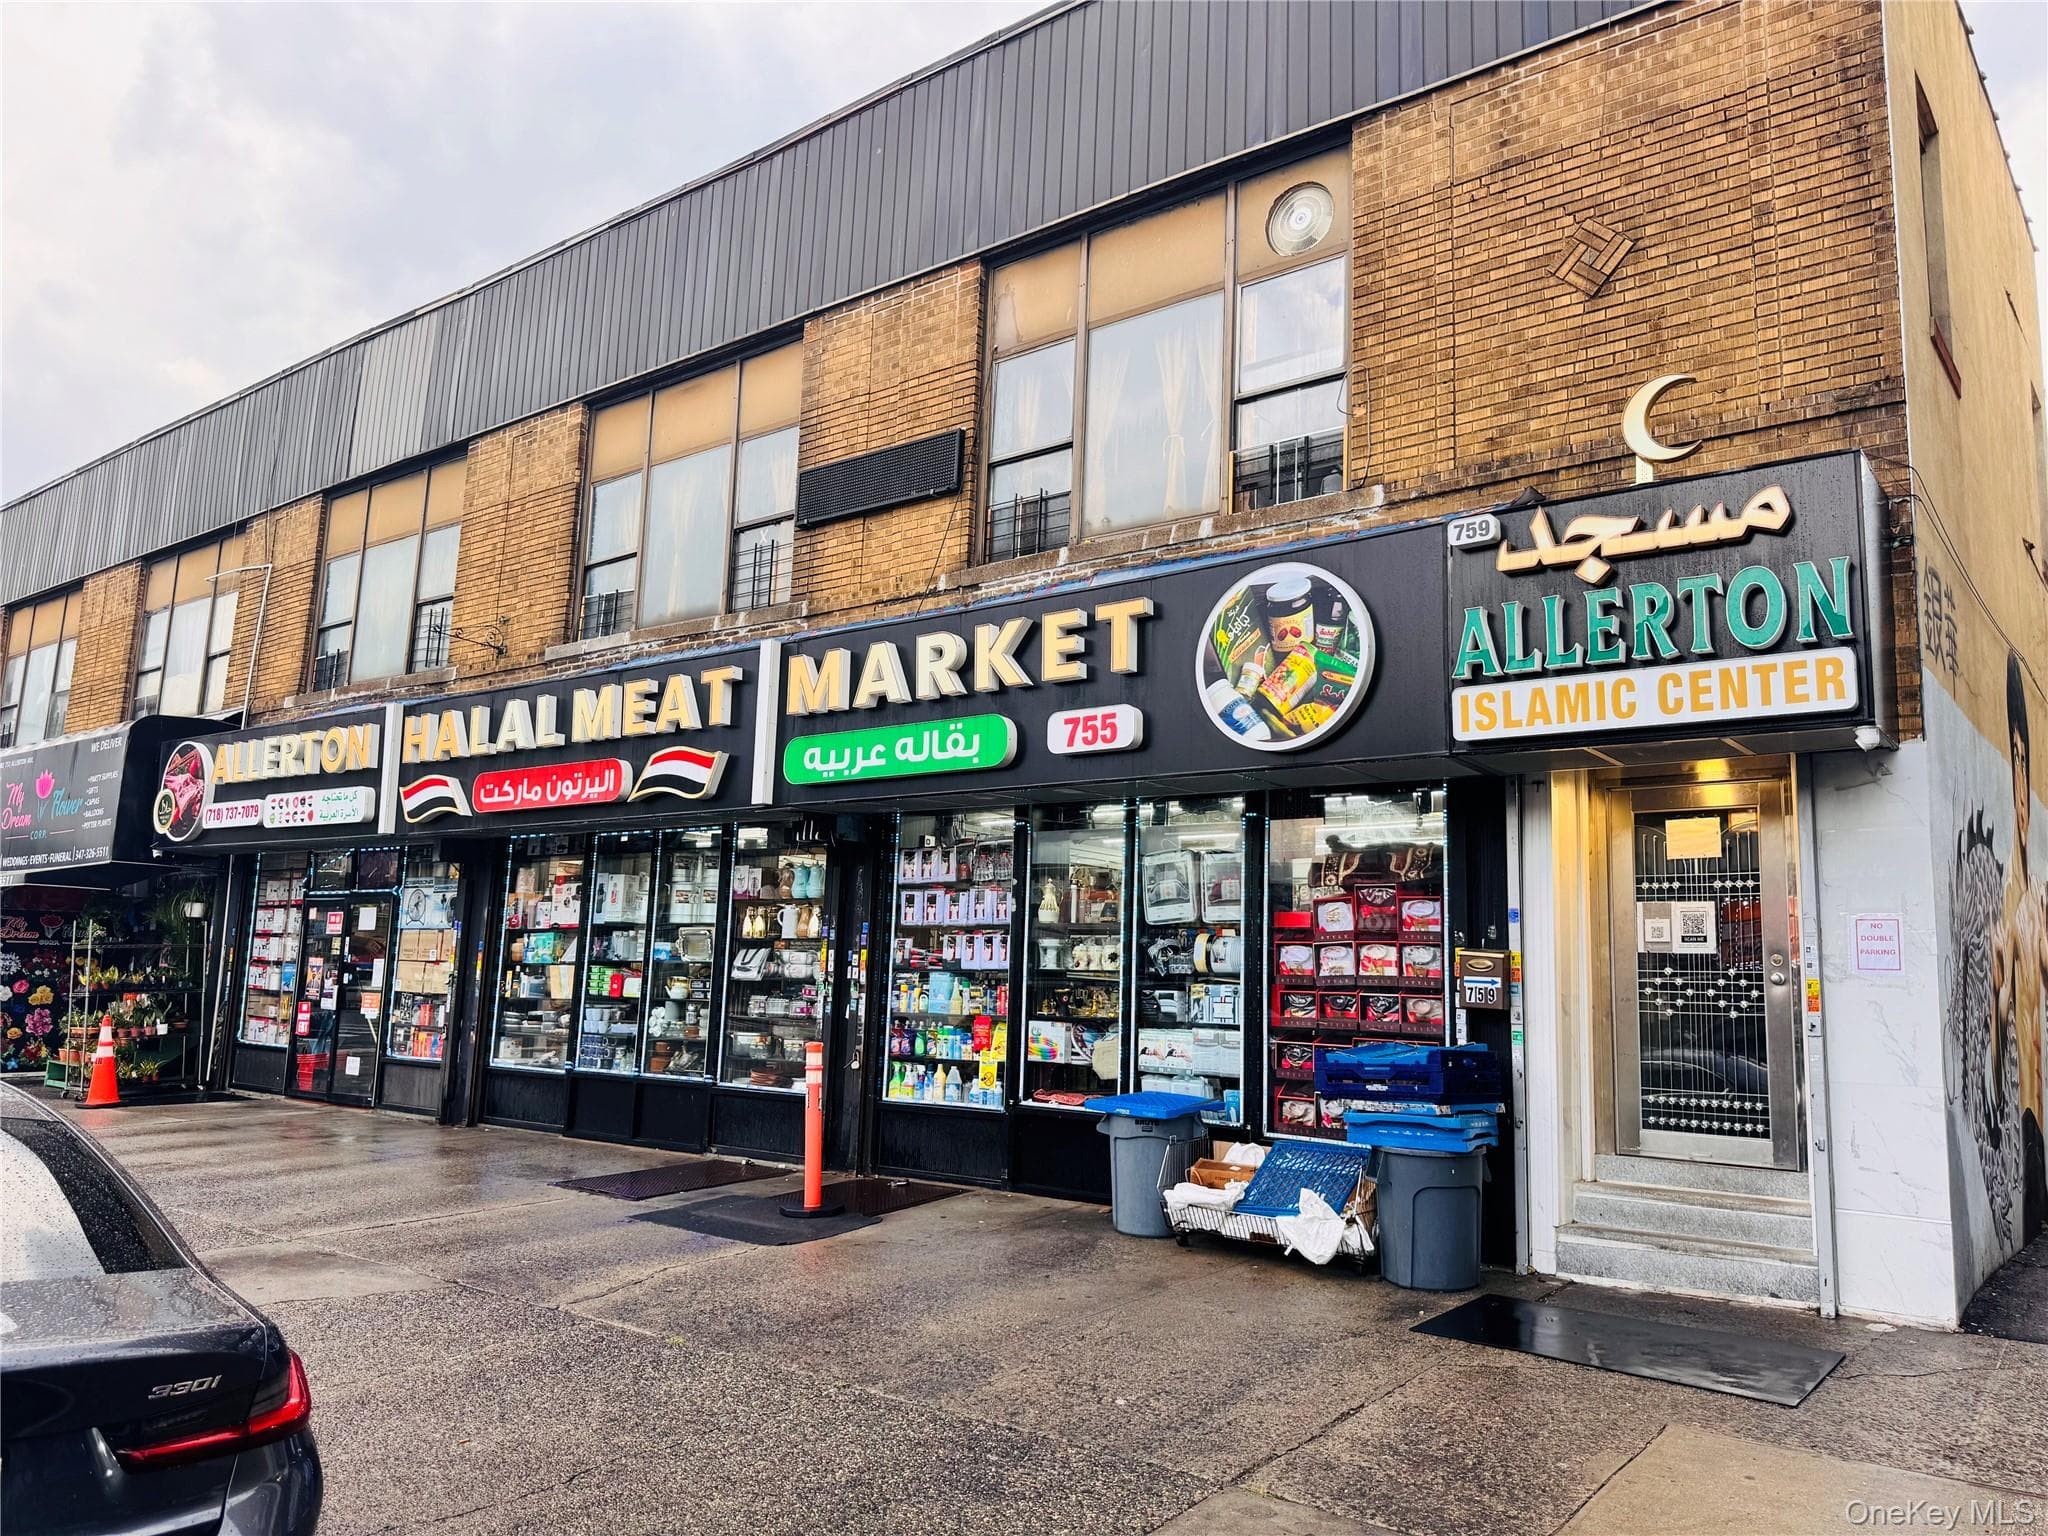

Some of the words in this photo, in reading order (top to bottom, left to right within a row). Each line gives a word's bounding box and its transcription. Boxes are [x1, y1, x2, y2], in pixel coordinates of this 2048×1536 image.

[1454, 518, 1491, 540] 759
[1496, 483, 1792, 586] مسجد
[1451, 555, 1856, 681] ALLERTON
[786, 597, 1154, 716] MARKET
[1459, 676, 1637, 733] ISLAMIC
[1657, 656, 1846, 714] CENTER
[402, 693, 566, 764] HALAL
[571, 665, 744, 744] MEAT
[1063, 711, 1119, 749] 755
[211, 723, 381, 784] ALLERTON
[6, 782, 25, 812] My
[480, 777, 543, 804] ماركت
[547, 767, 615, 803] اليرتون
[1, 808, 32, 830] Dream
[205, 807, 223, 822] (718)
[225, 804, 259, 820] 737-7079
[1467, 986, 1496, 1004] 759
